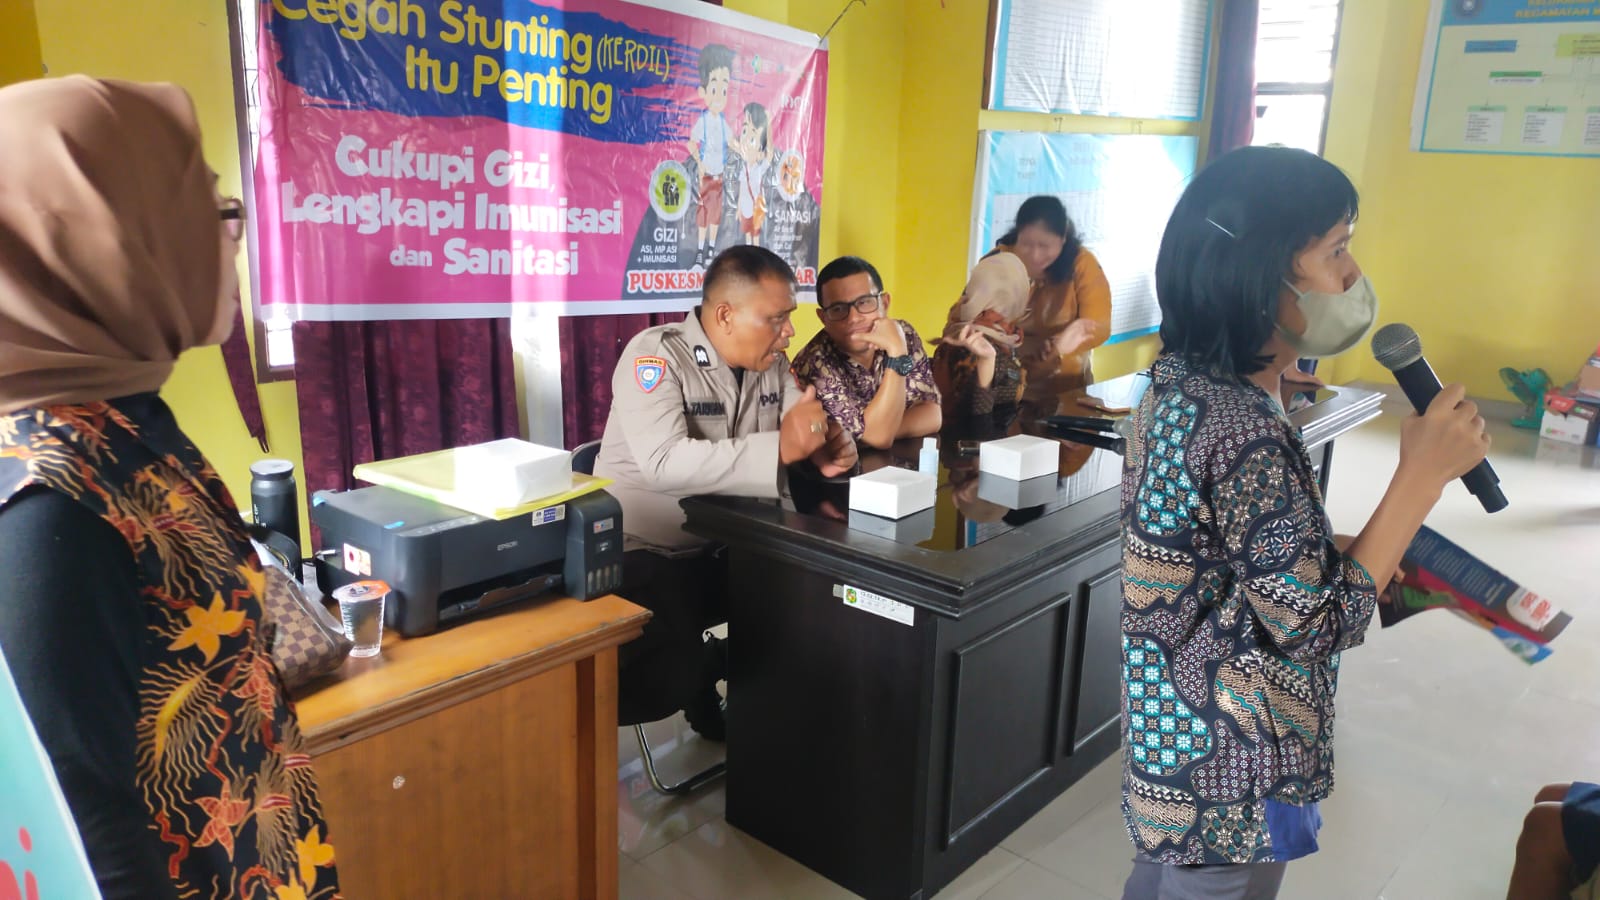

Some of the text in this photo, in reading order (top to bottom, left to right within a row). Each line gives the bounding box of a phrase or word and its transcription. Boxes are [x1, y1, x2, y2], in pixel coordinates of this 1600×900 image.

[271, 0, 670, 82] Cegah Stunting (KERDIL)
[405, 45, 613, 124] Itu Penting
[335, 135, 555, 193] Cukupi Gizi,
[282, 181, 622, 236] Lengkapi Imunisasi
[389, 237, 579, 276] dan Sanitasi
[653, 227, 678, 242] GIZI
[666, 245, 677, 253] ASI
[643, 254, 677, 263] IMUNISASI
